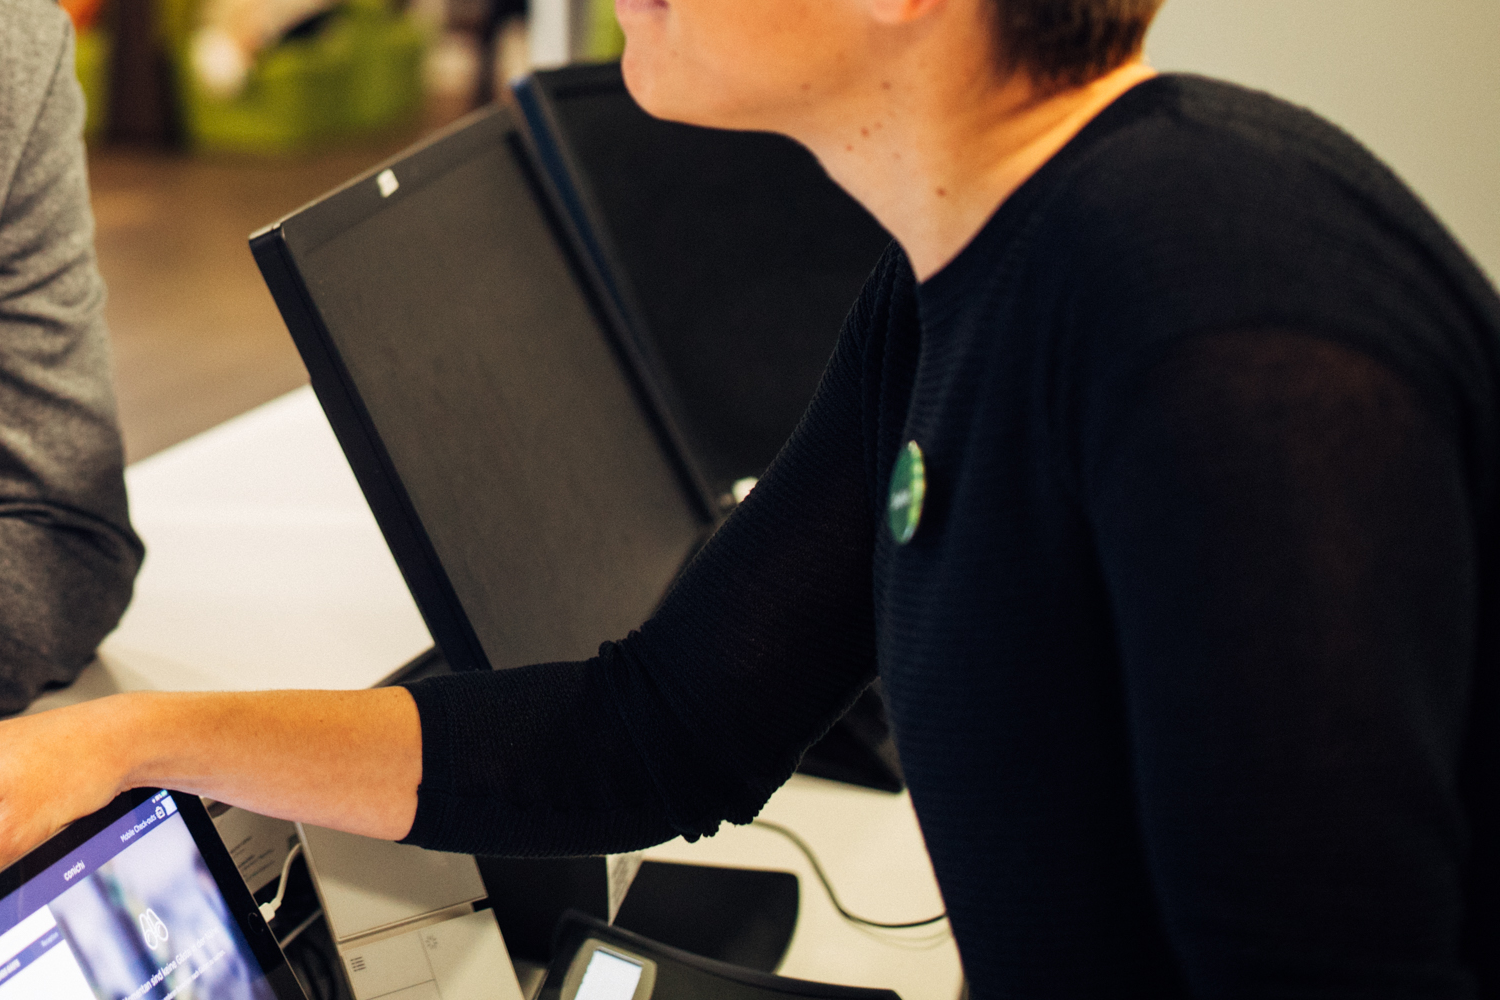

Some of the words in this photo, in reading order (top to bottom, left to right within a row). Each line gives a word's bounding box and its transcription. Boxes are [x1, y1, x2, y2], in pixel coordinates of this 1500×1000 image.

[63, 860, 86, 881] conichi
[121, 980, 153, 1000] mentan
[150, 969, 164, 987] sind
[161, 960, 178, 977] keine
